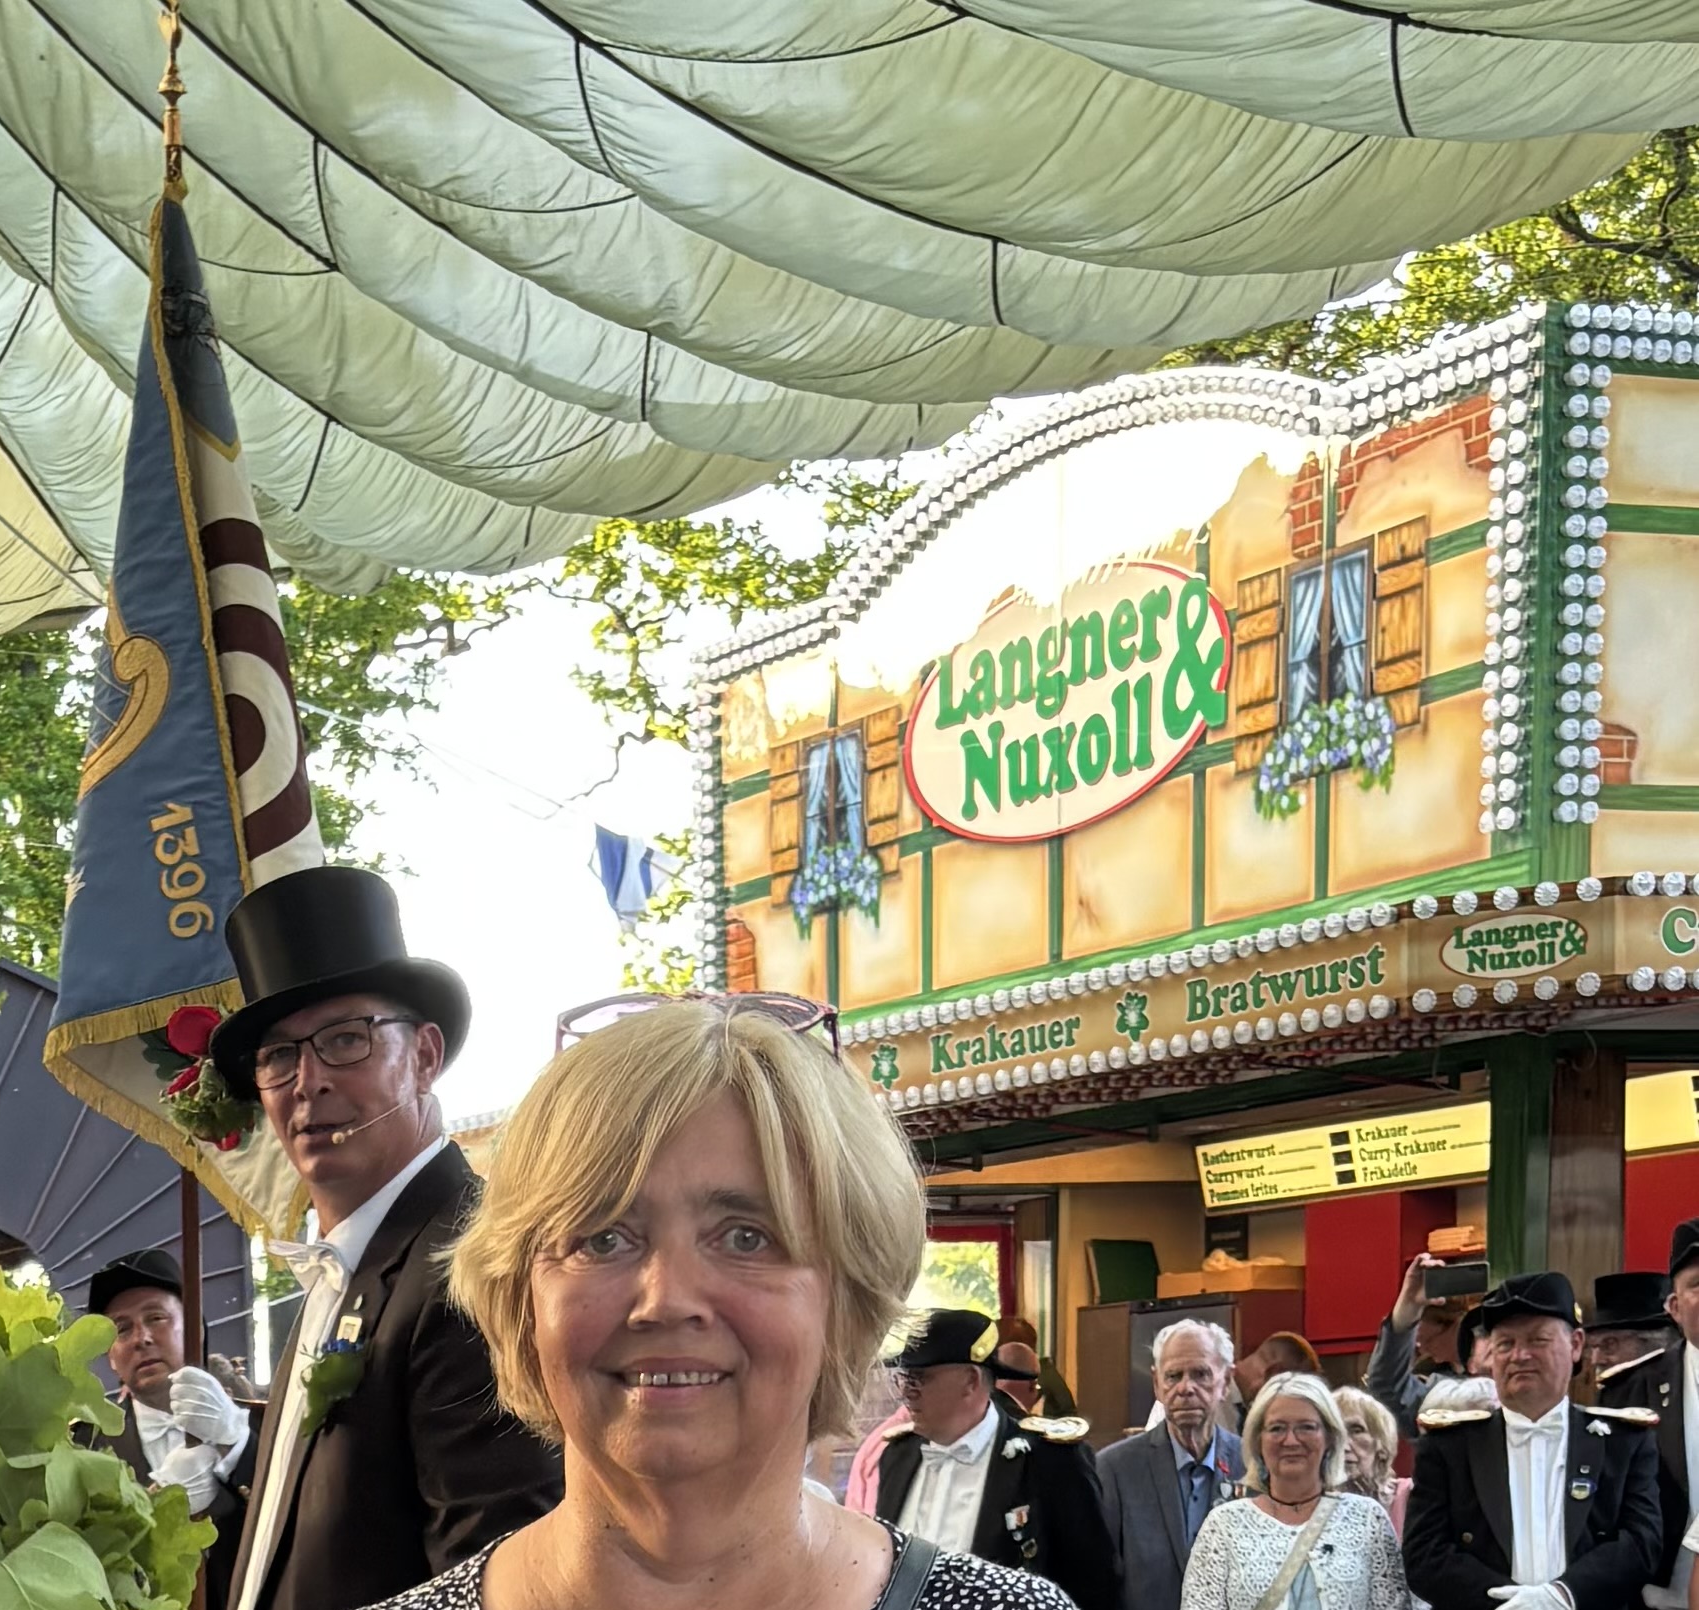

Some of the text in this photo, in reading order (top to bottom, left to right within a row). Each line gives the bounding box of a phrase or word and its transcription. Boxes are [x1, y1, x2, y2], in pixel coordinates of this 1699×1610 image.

[935, 578, 1228, 740] Langner &
[959, 671, 1155, 822] Nuxoll
[150, 802, 215, 939] 1396
[1453, 919, 1588, 957] Langner &
[1661, 907, 1699, 956] C
[1466, 940, 1557, 973] Nuxoll
[1185, 942, 1386, 1023] Bratwurst
[929, 1015, 1081, 1074] Krakauer
[1355, 1125, 1409, 1144] Krakauer
[1359, 1138, 1448, 1163] Curry-Krakauer
[1205, 1165, 1266, 1184] Currywurst
[1361, 1161, 1419, 1183] Frikadelle
